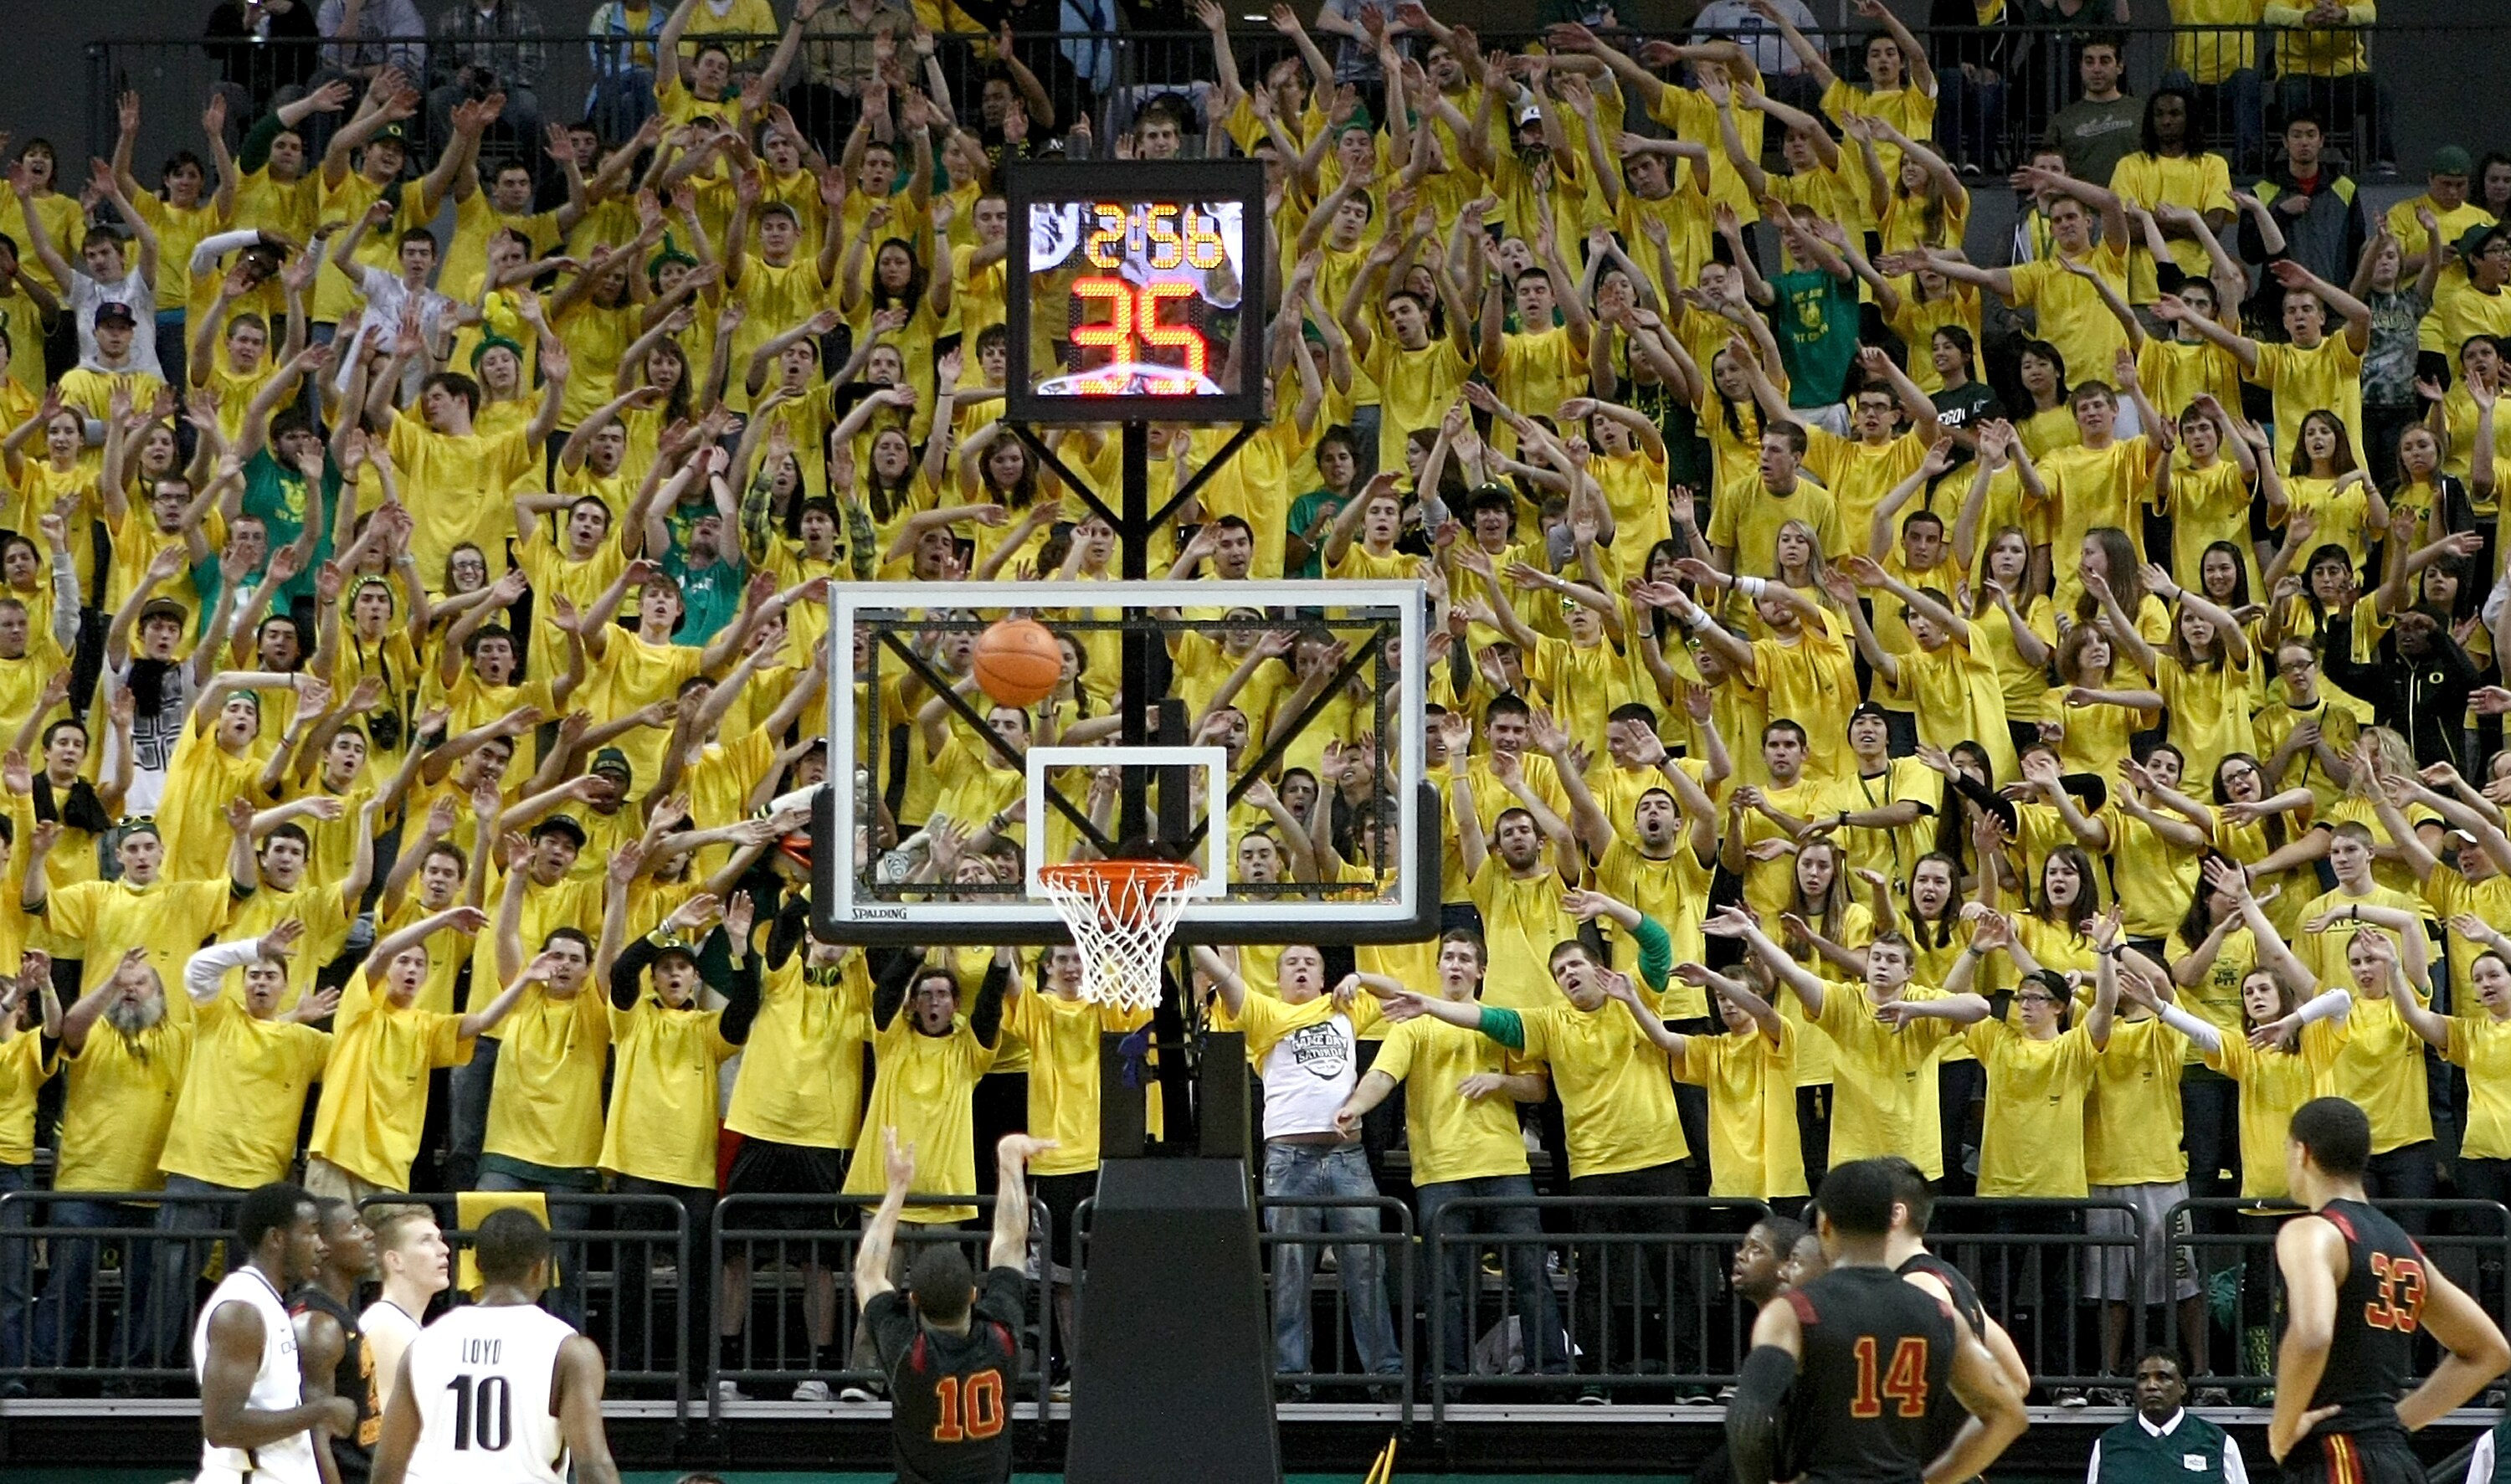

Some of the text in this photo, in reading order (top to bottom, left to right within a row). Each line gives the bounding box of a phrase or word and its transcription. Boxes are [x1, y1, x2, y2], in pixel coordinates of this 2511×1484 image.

[1088, 203, 1224, 270] 2:56
[1071, 278, 1206, 394] 35
[852, 906, 907, 921] SPALDING
[2364, 1251, 2427, 1333] 33
[462, 1338, 502, 1366] LOYD
[1850, 1334, 1928, 1418] 14
[447, 1374, 512, 1451] 10
[933, 1368, 1005, 1443] 10
